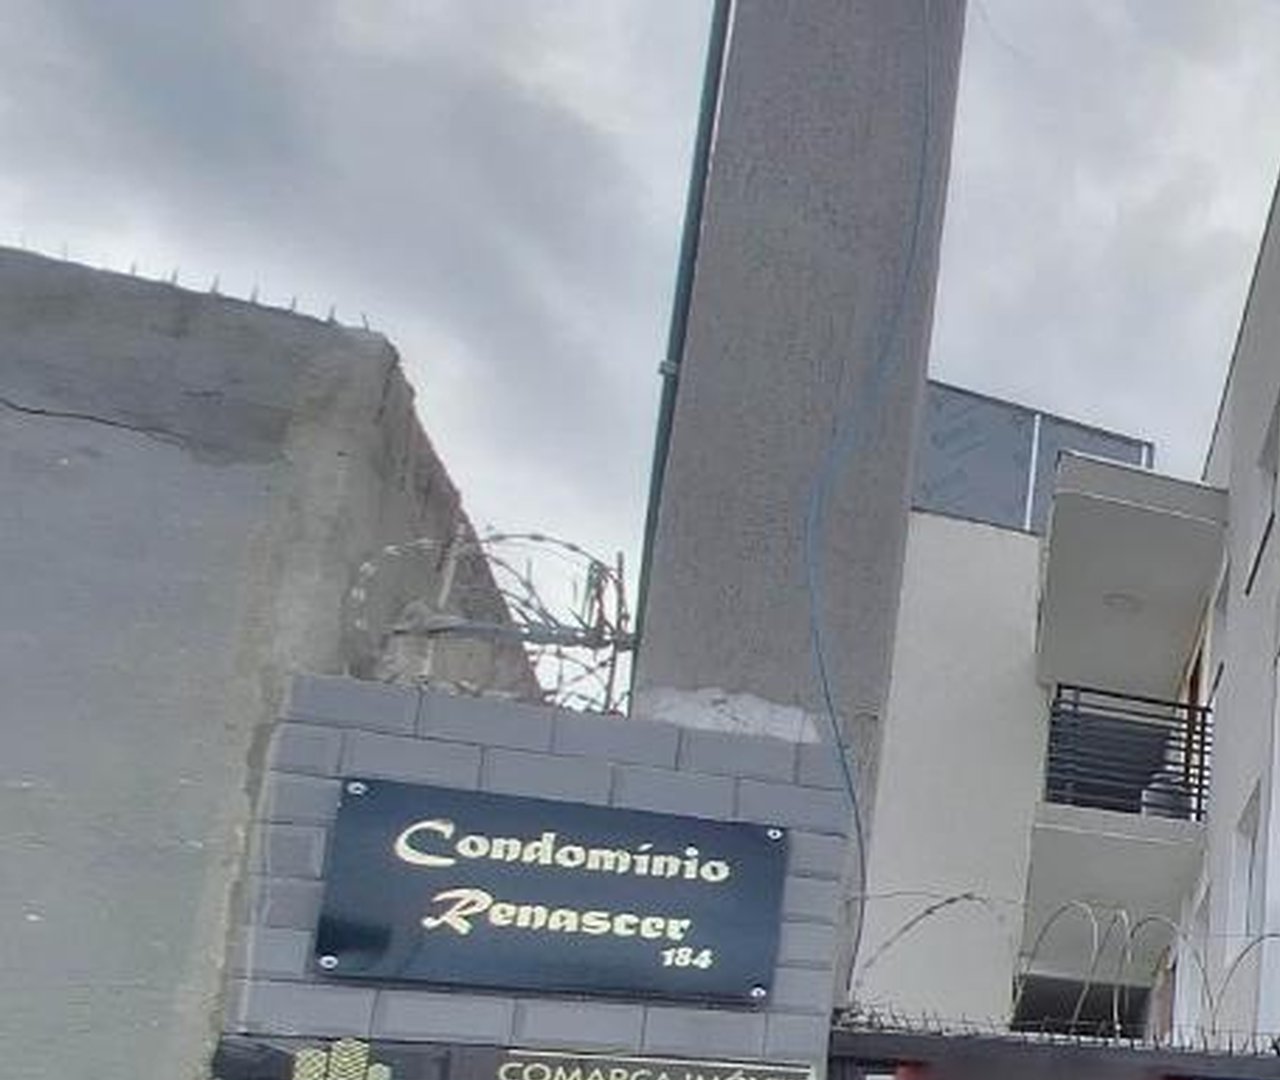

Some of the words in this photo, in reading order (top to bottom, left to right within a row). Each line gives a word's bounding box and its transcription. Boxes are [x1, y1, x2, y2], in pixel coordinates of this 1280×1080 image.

[393, 817, 732, 884] Condomínio
[421, 887, 693, 943] Renascer
[661, 945, 714, 970] 184
